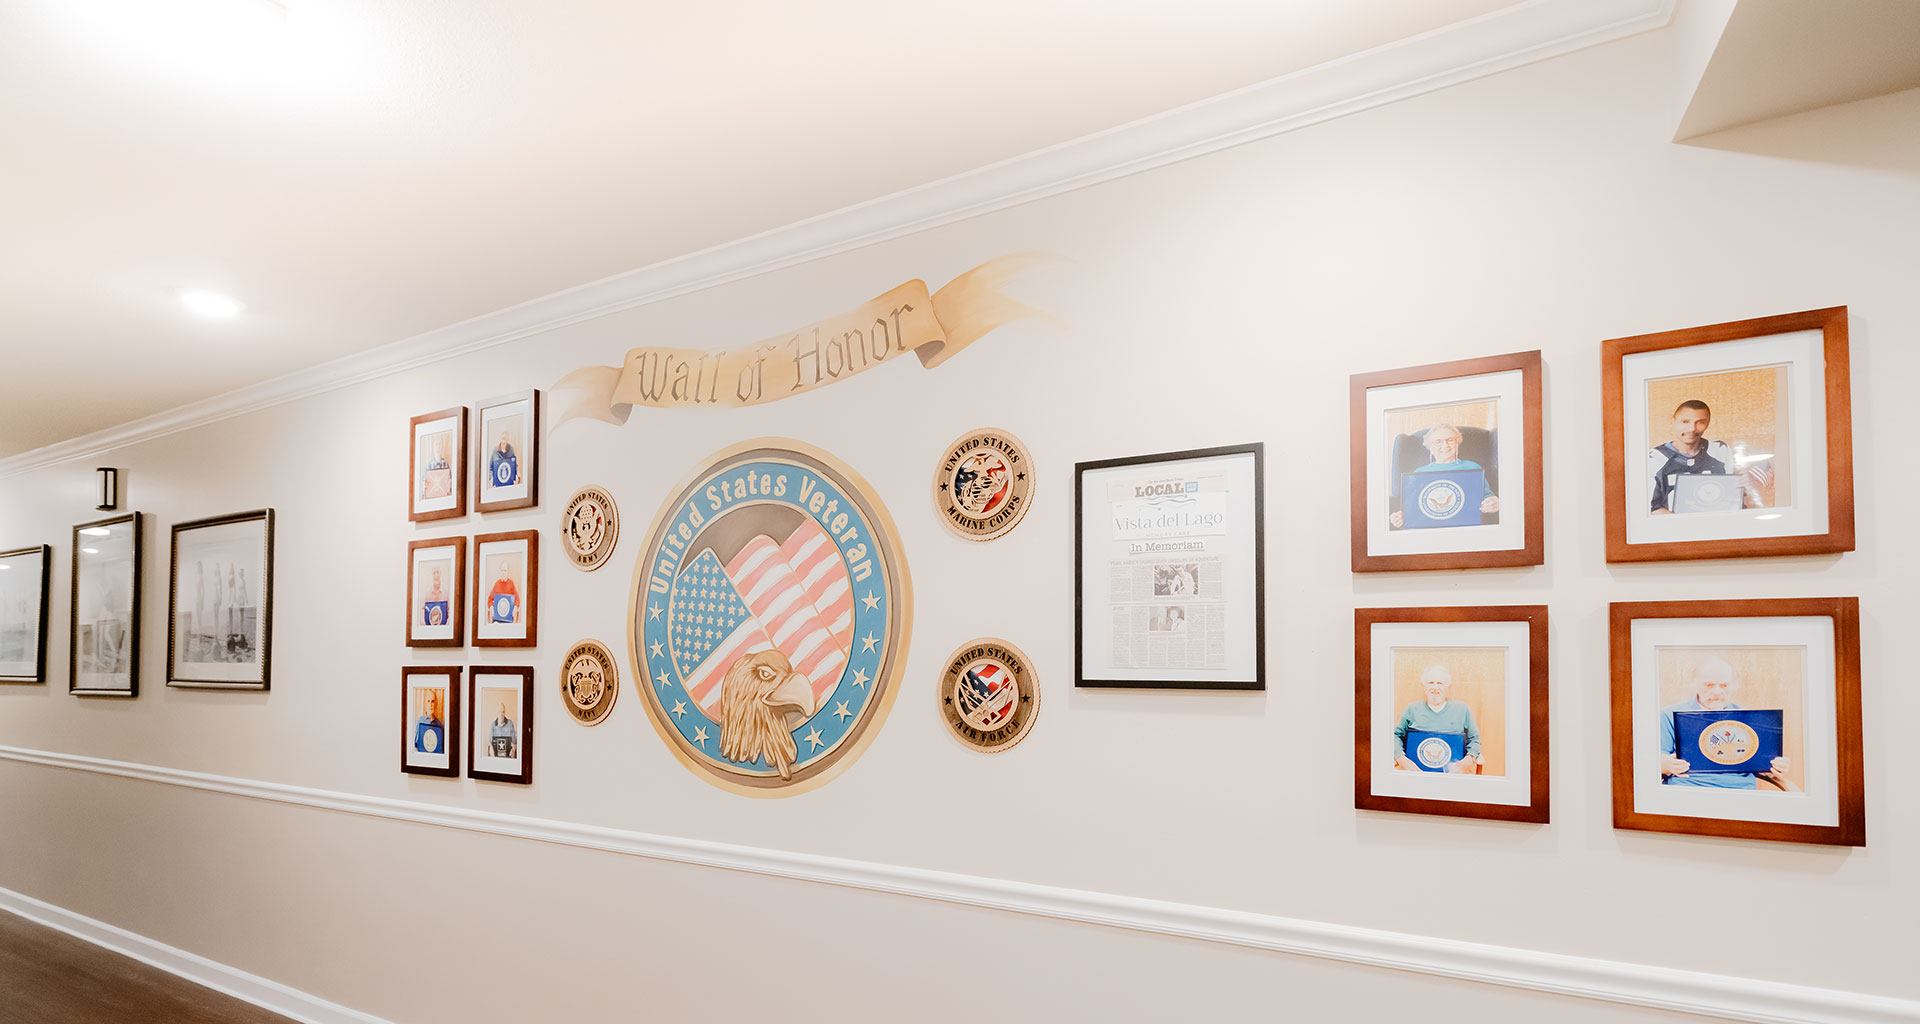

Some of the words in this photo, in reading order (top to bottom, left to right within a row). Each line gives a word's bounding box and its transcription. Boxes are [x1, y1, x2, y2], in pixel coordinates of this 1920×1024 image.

[635, 350, 727, 405] Wall
[736, 344, 778, 403] of
[790, 302, 915, 393] Honor
[945, 438, 980, 472] UNITED
[983, 436, 1020, 463] STATES
[1135, 483, 1185, 498] LOCAL
[566, 493, 587, 516] UNITED
[588, 491, 609, 510] STATES
[947, 505, 985, 530] MARINE
[989, 495, 1021, 528] CORPS
[650, 508, 705, 595] United
[706, 470, 788, 511] States
[799, 476, 874, 583] Veteran
[1115, 517, 1152, 531] Vista
[1156, 513, 1179, 528] del
[1185, 512, 1223, 528] Lago
[577, 553, 598, 564] ARMY
[1131, 543, 1142, 552] In
[1145, 541, 1204, 552] Memoriam
[565, 646, 586, 671] UNITED
[587, 646, 609, 670] STATES
[950, 648, 984, 675] UNITED
[987, 647, 1023, 675] STATES
[579, 709, 596, 719] NAVY
[955, 720, 977, 739] AIR
[981, 719, 1021, 742] FORCE
